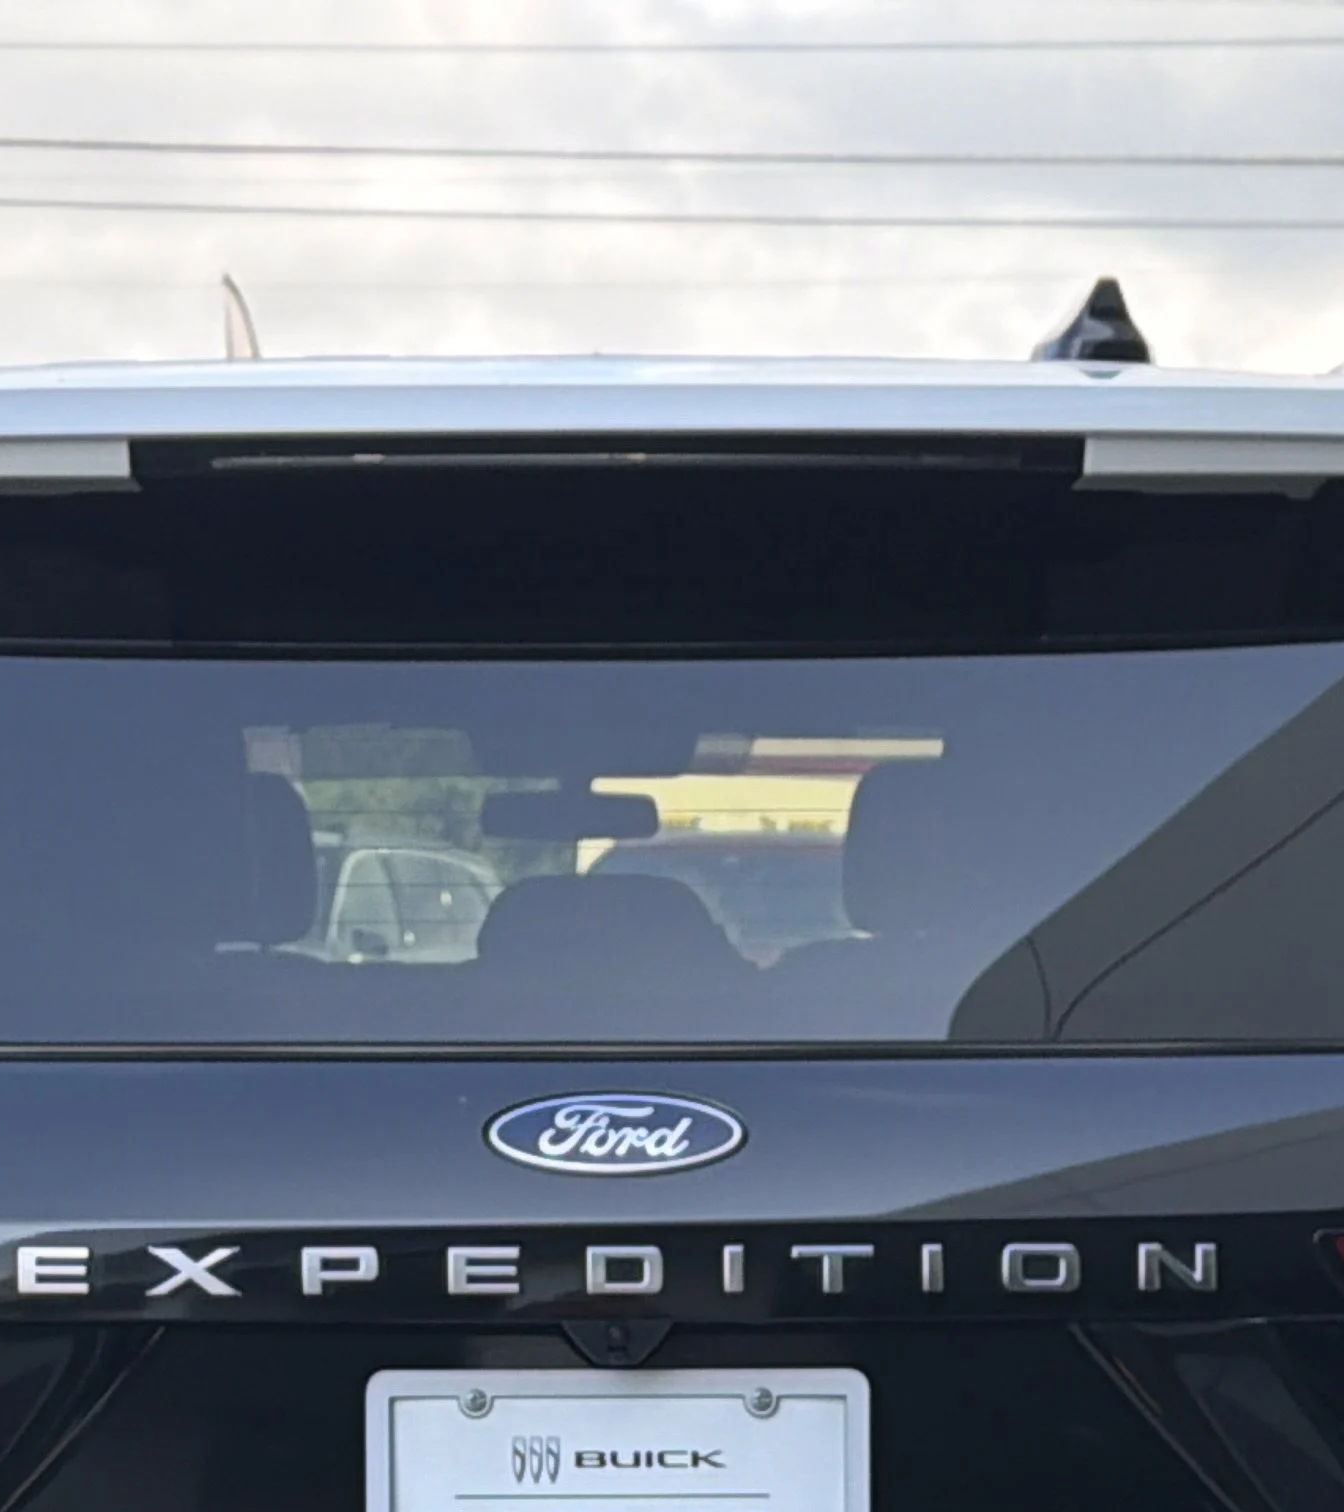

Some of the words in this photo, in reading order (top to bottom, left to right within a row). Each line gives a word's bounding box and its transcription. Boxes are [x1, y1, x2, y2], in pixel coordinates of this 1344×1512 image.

[538, 1103, 690, 1159] Ford
[14, 1242, 1219, 1297] EXPEDITION
[573, 1449, 727, 1470] BUICK
